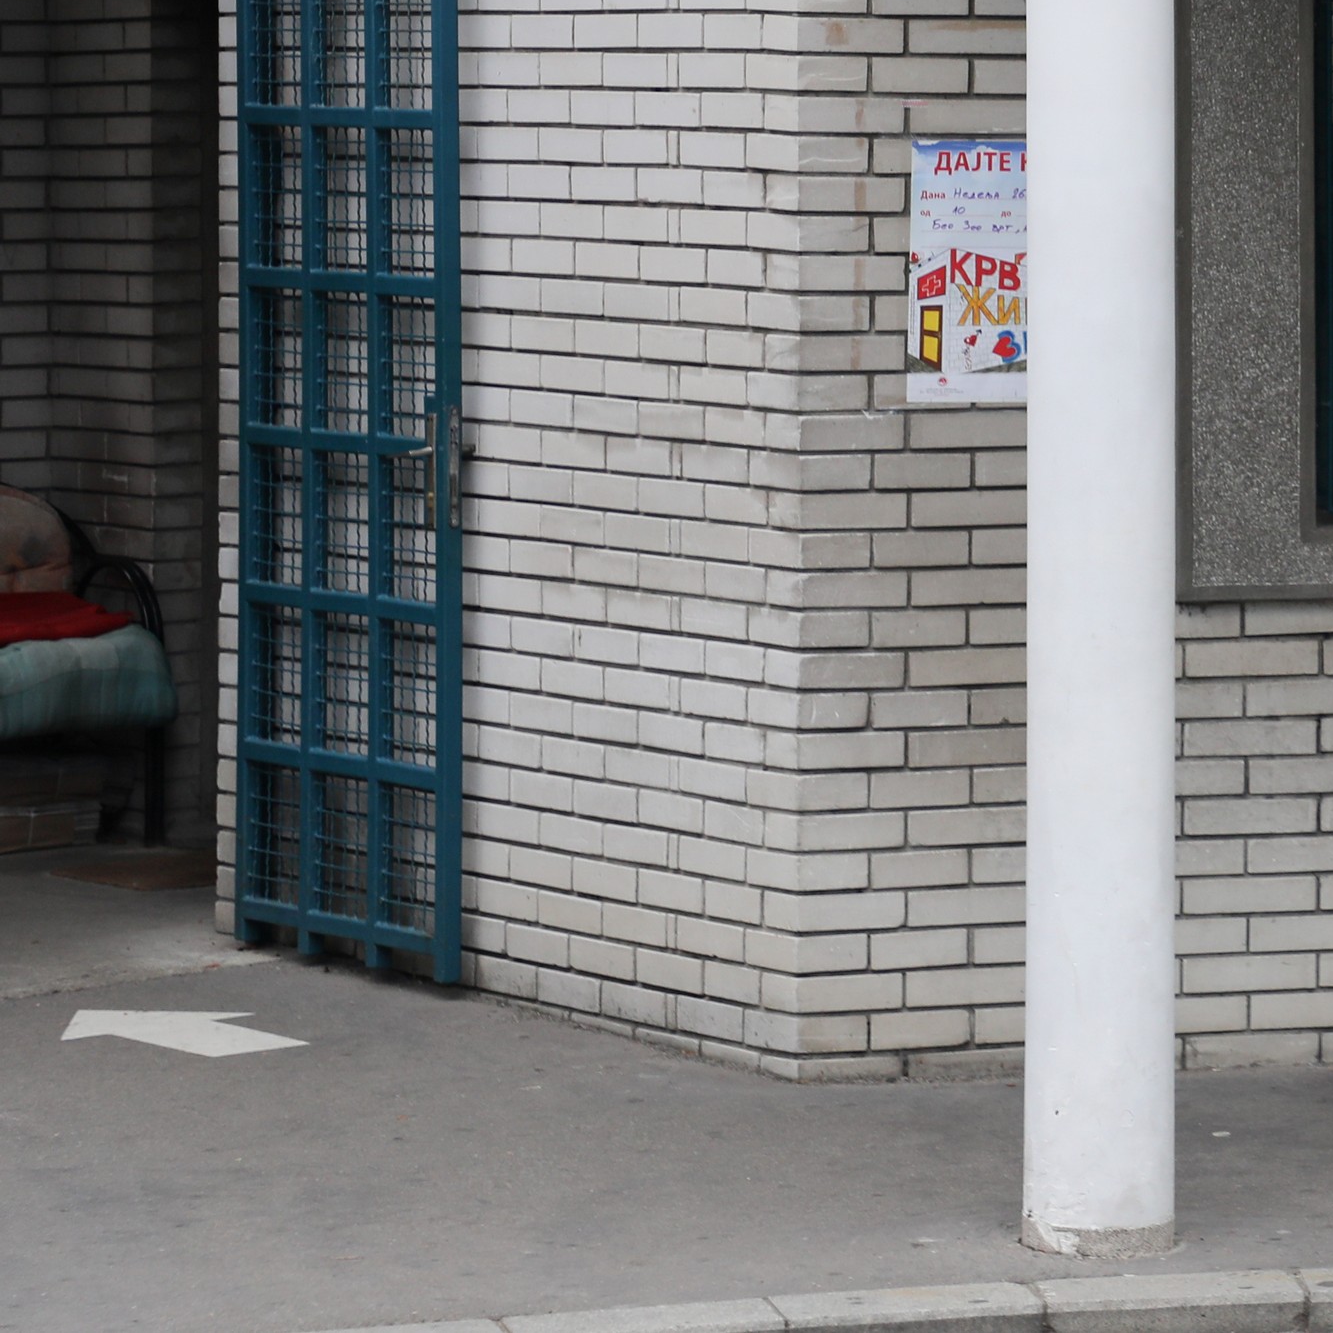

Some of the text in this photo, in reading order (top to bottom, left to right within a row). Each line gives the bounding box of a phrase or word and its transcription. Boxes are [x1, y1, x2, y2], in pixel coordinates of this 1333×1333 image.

[934, 151, 1012, 176] ДАЈТЕ
[920, 190, 946, 201] Дана
[920, 210, 931, 218] од
[1000, 209, 1012, 218] до
[950, 248, 1022, 291] КРВ
